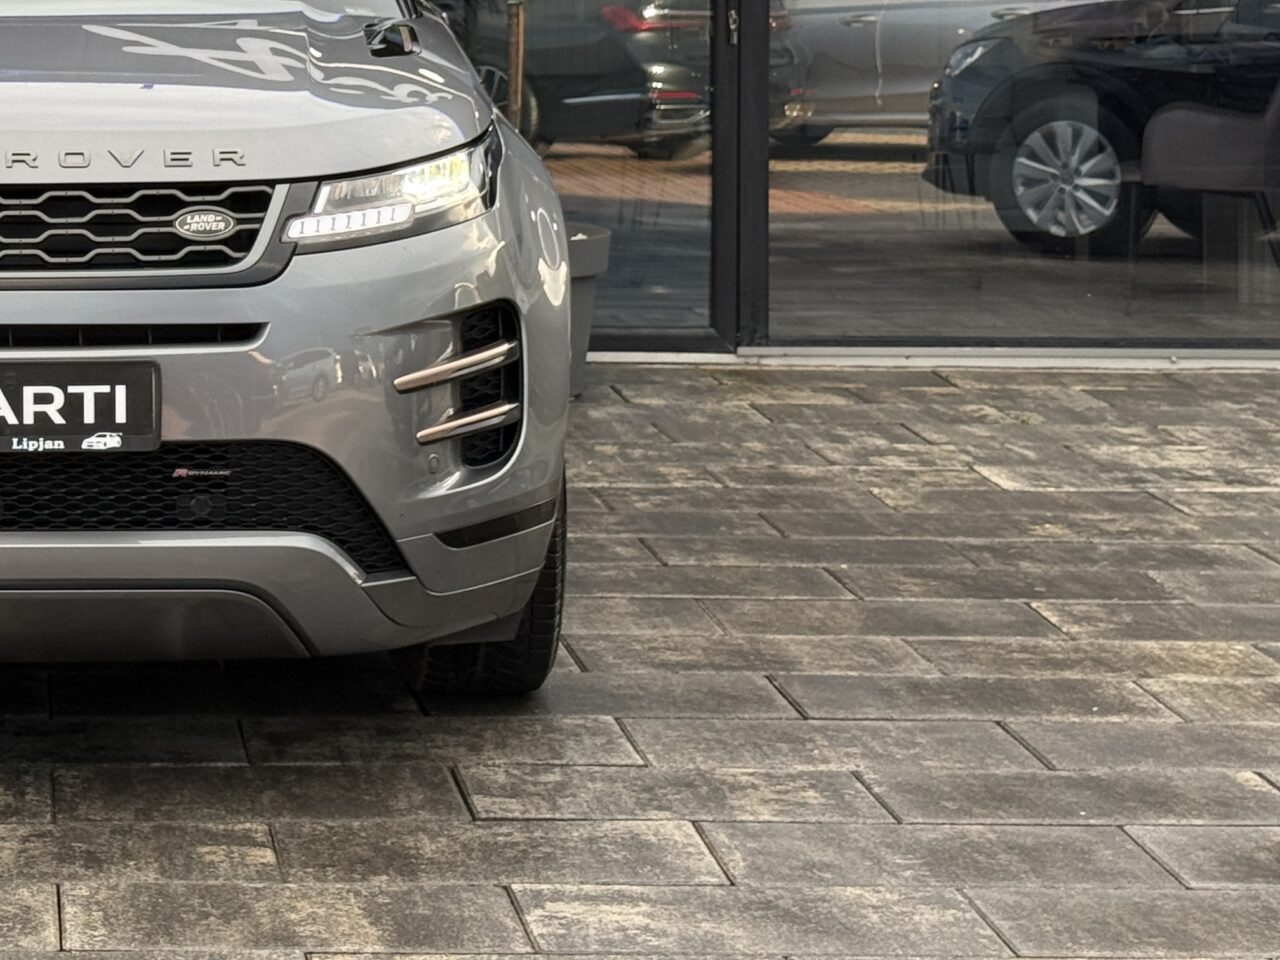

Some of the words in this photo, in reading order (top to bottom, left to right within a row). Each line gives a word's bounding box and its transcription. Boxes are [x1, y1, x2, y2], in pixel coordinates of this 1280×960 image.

[5, 148, 246, 169] ROVER
[186, 214, 216, 224] LAND
[189, 221, 226, 232] ROVER
[11, 437, 66, 452] Lipjan
